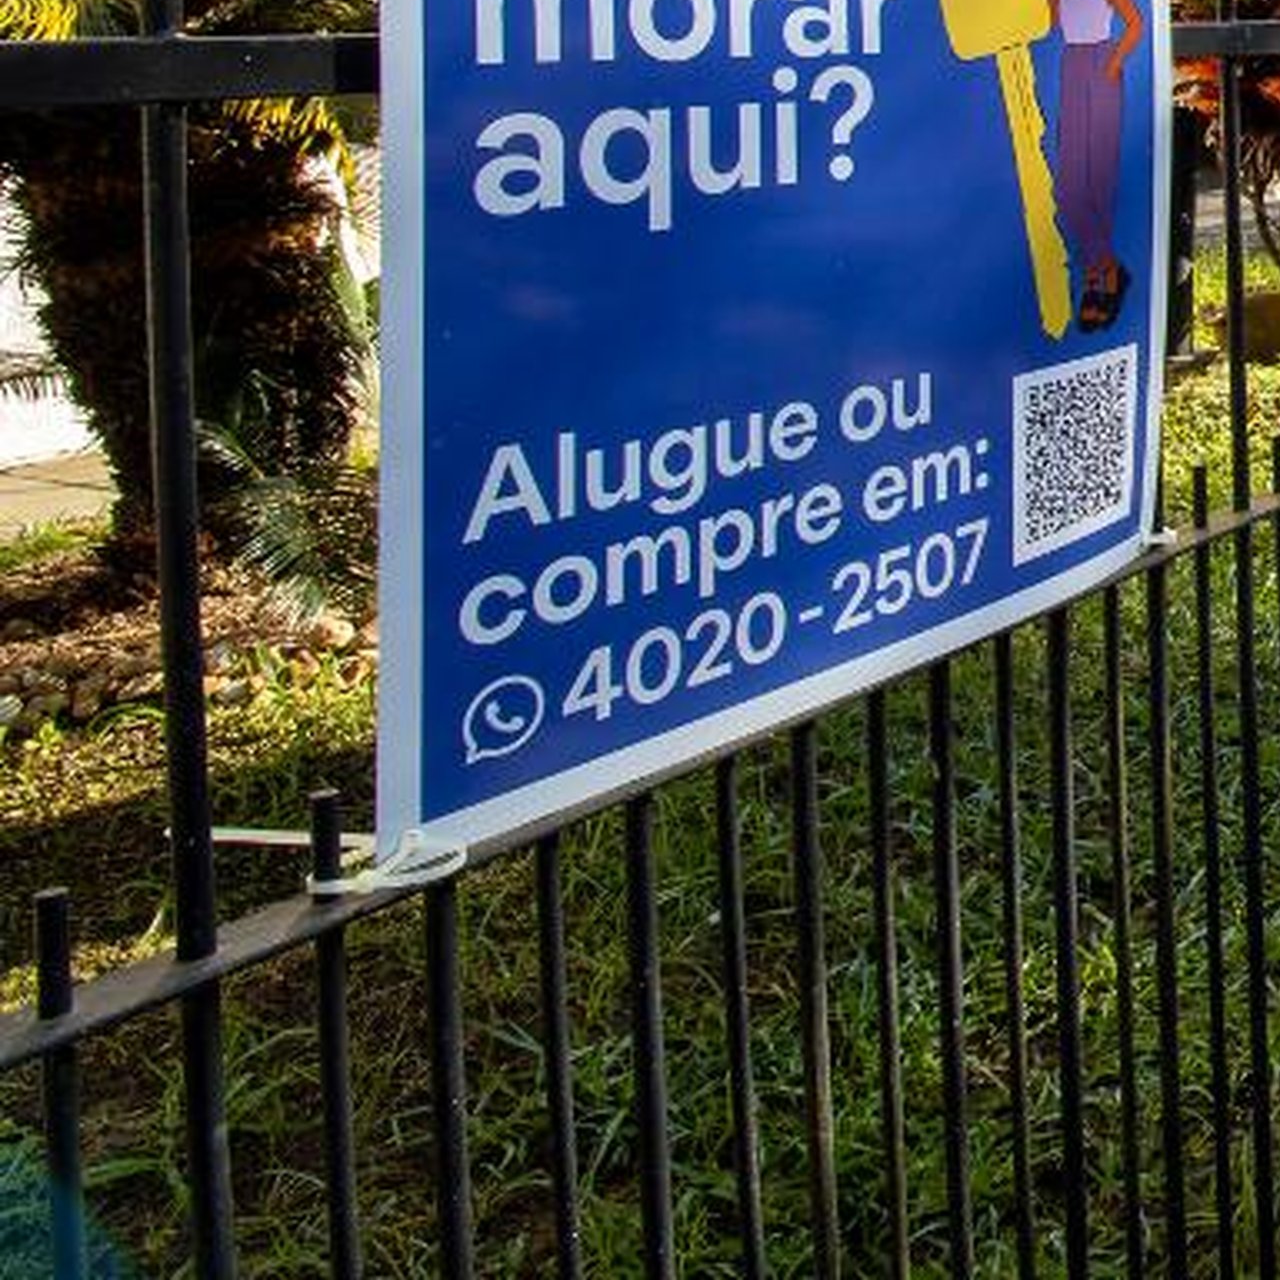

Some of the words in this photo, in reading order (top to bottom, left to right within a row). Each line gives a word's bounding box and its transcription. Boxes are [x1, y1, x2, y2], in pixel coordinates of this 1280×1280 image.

[472, 65, 876, 233] aqui?
[458, 481, 843, 646] compre
[862, 438, 991, 522] em:
[461, 400, 818, 545] Alugue
[840, 372, 933, 442] ou
[561, 521, 989, 722] 4020-2507
